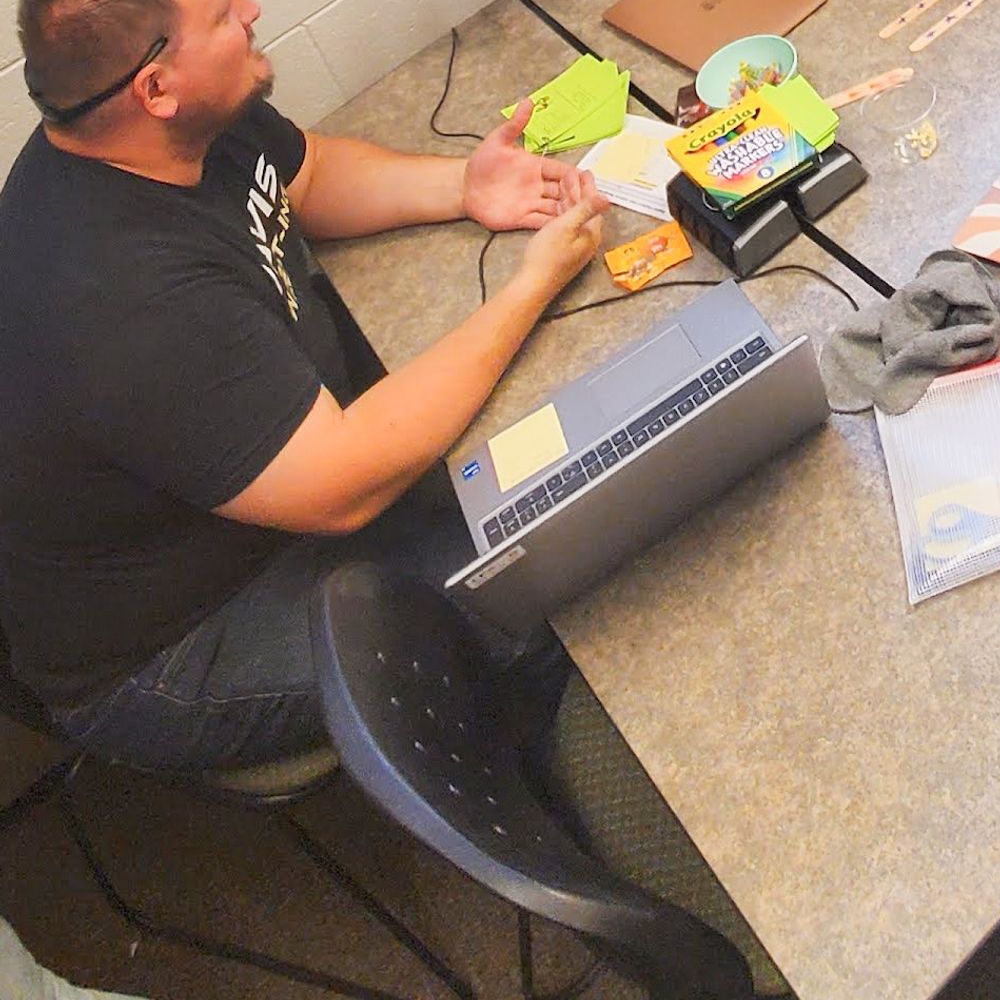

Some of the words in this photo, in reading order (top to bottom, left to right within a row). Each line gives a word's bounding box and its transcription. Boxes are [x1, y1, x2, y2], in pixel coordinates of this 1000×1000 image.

[688, 108, 753, 149] Crayola
[706, 127, 785, 177] WASHABLE
[721, 140, 786, 180] MARKERS
